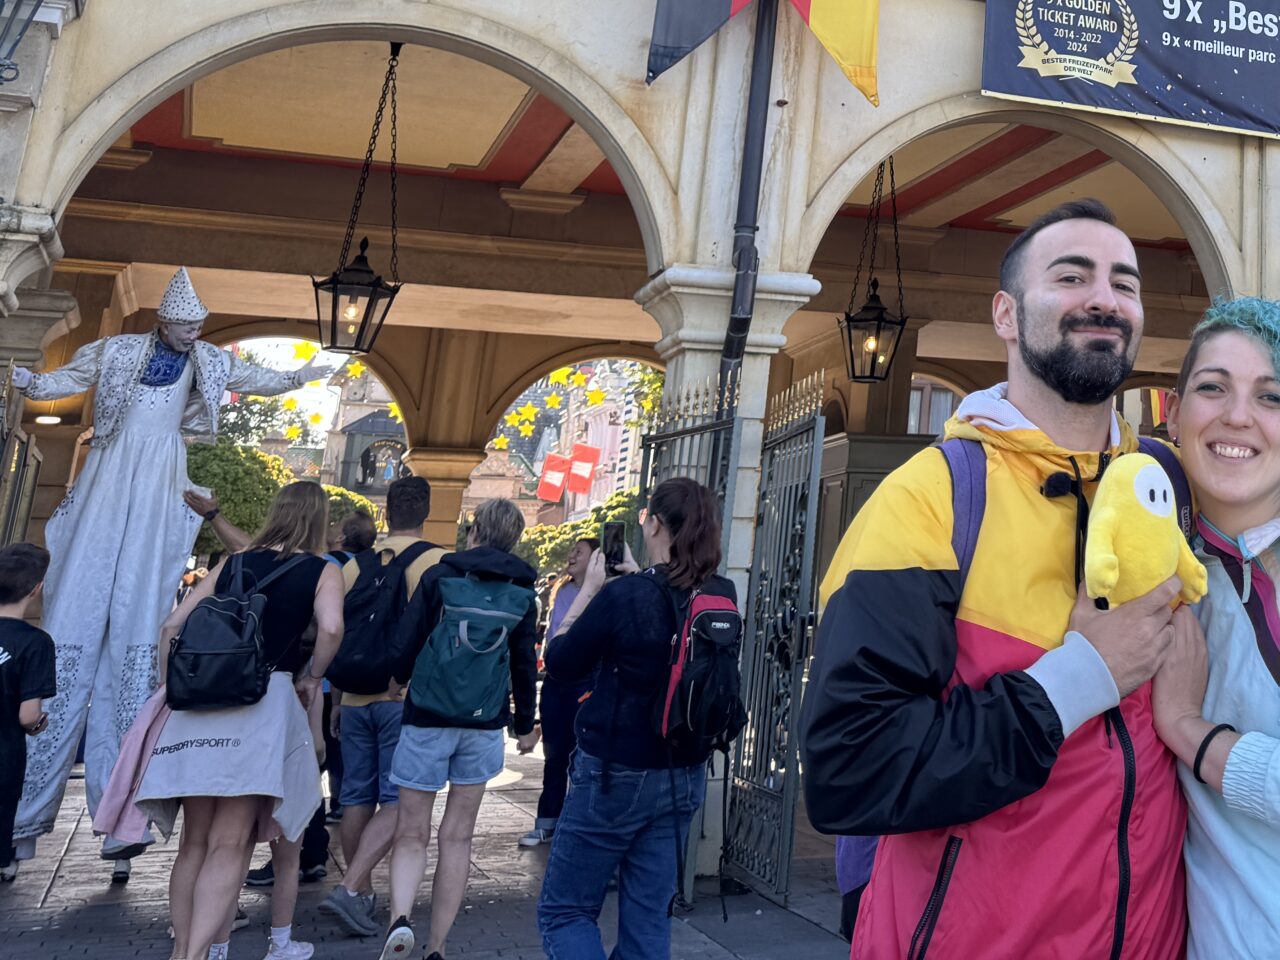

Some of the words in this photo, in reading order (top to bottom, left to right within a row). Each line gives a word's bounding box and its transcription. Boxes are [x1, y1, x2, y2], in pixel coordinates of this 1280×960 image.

[1037, 7, 1076, 25] TICKET
[1078, 15, 1118, 33] AWARD
[1066, 41, 1088, 53] 2024
[1162, 31, 1171, 46] 9
[1172, 36, 1180, 48] x
[1193, 39, 1246, 58] meilleur
[1248, 47, 1276, 63] parc
[1068, 58, 1113, 75] FREIZEITPARK
[1077, 67, 1094, 76] WELT
